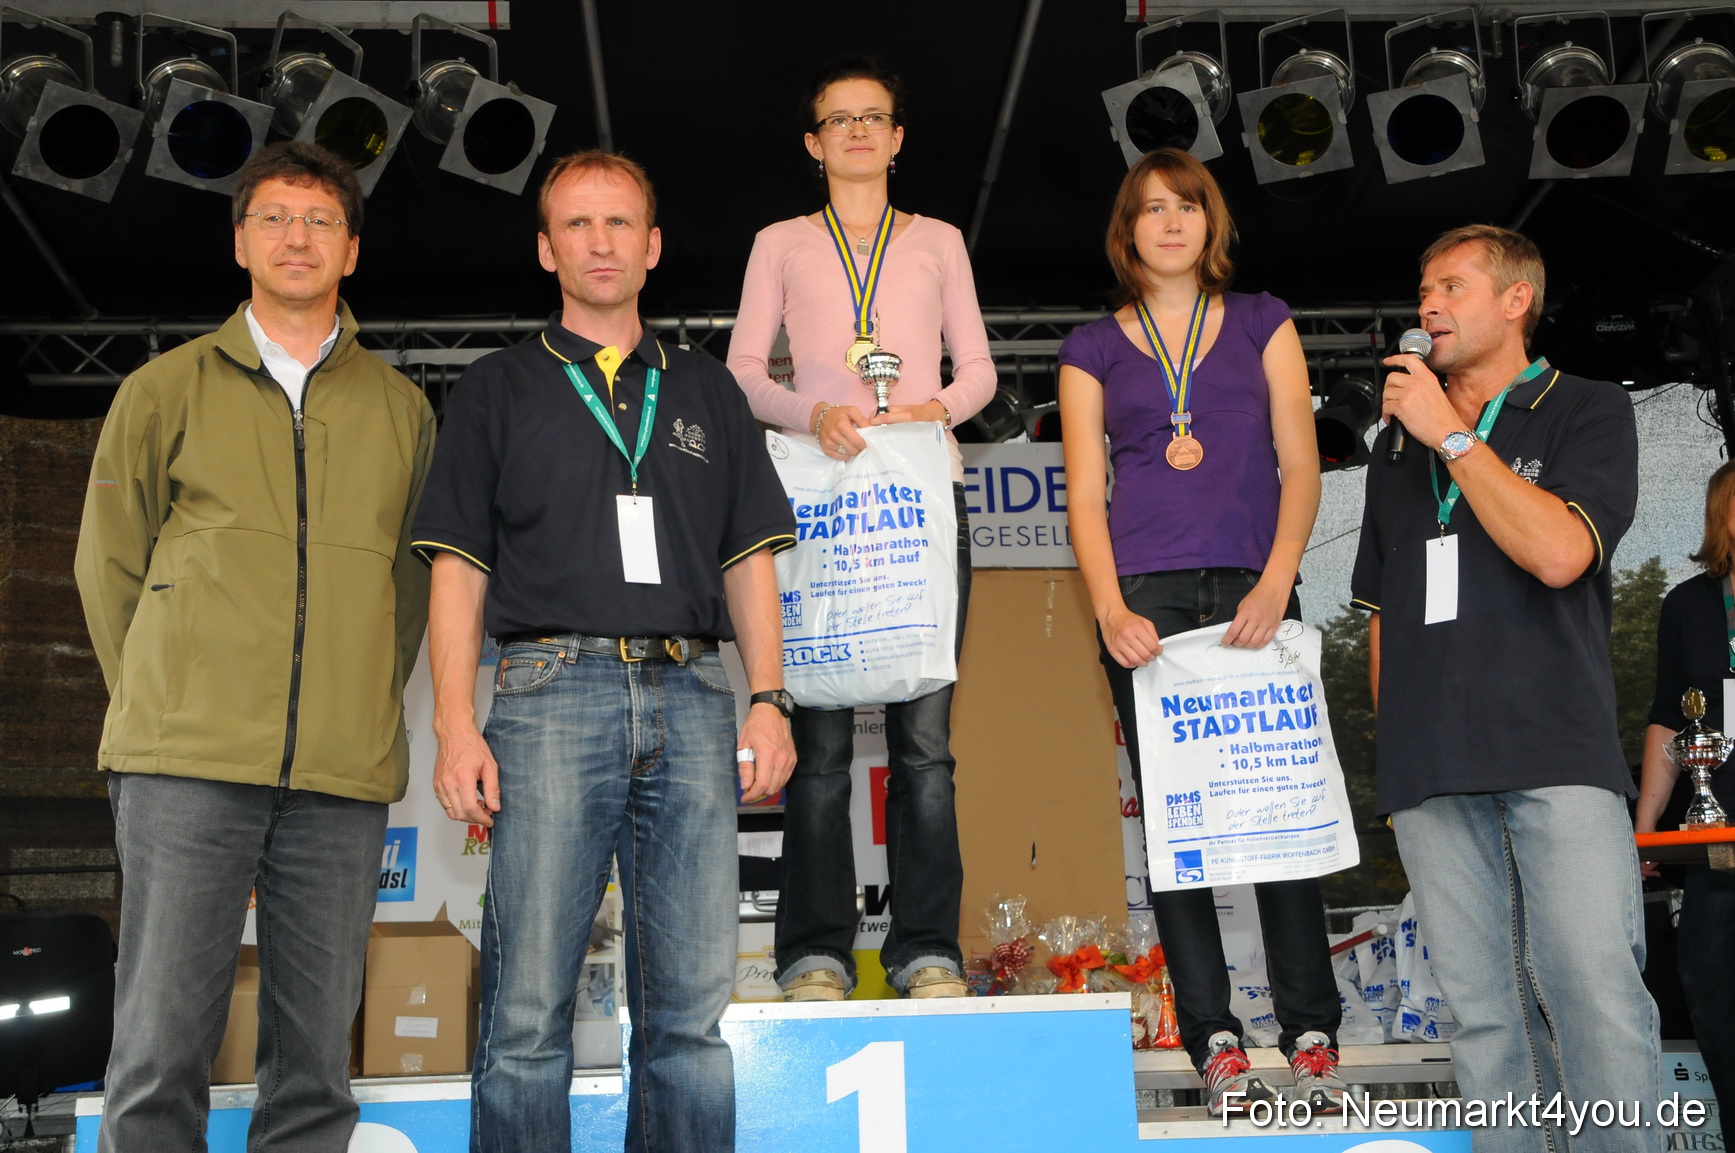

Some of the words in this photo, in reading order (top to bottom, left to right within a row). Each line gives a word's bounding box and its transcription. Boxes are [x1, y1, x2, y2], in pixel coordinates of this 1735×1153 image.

[795, 506, 926, 541] TADTLAUF
[833, 537, 929, 557] Halbmarathon
[834, 557, 861, 573] 10,5
[865, 556, 886, 569] km
[890, 550, 920, 565] Lauf
[873, 583, 895, 592] guten
[897, 579, 927, 587] Zweck!
[781, 603, 802, 617] BEN
[783, 643, 852, 667] BOCK
[1160, 681, 1314, 718] Neumarkter
[1172, 703, 1318, 743] STADTLAUF
[1229, 736, 1323, 755] Halbmarathon
[1232, 756, 1262, 771] 10,5
[1266, 755, 1287, 768] km
[1291, 751, 1320, 766] Lauf
[1208, 777, 1260, 788] Unterstützen
[1262, 775, 1274, 783] Sie
[1209, 789, 1236, 797] Laufen
[1252, 785, 1274, 793] einen
[1276, 783, 1299, 792] guten
[1300, 778, 1327, 789] Zweck!
[1167, 802, 1202, 820] LEBEN
[1226, 807, 1251, 819] Oder
[1256, 801, 1287, 813] wollen
[1289, 796, 1306, 807] Sie
[1311, 788, 1327, 803] auf
[1167, 815, 1204, 829] SPENDEN
[1250, 813, 1278, 827] Stelle
[1211, 853, 1281, 865] PE-KUNSTOFF-FABRIK
[1282, 848, 1321, 858] WOFFENBACH
[826, 1041, 907, 1153] 1
